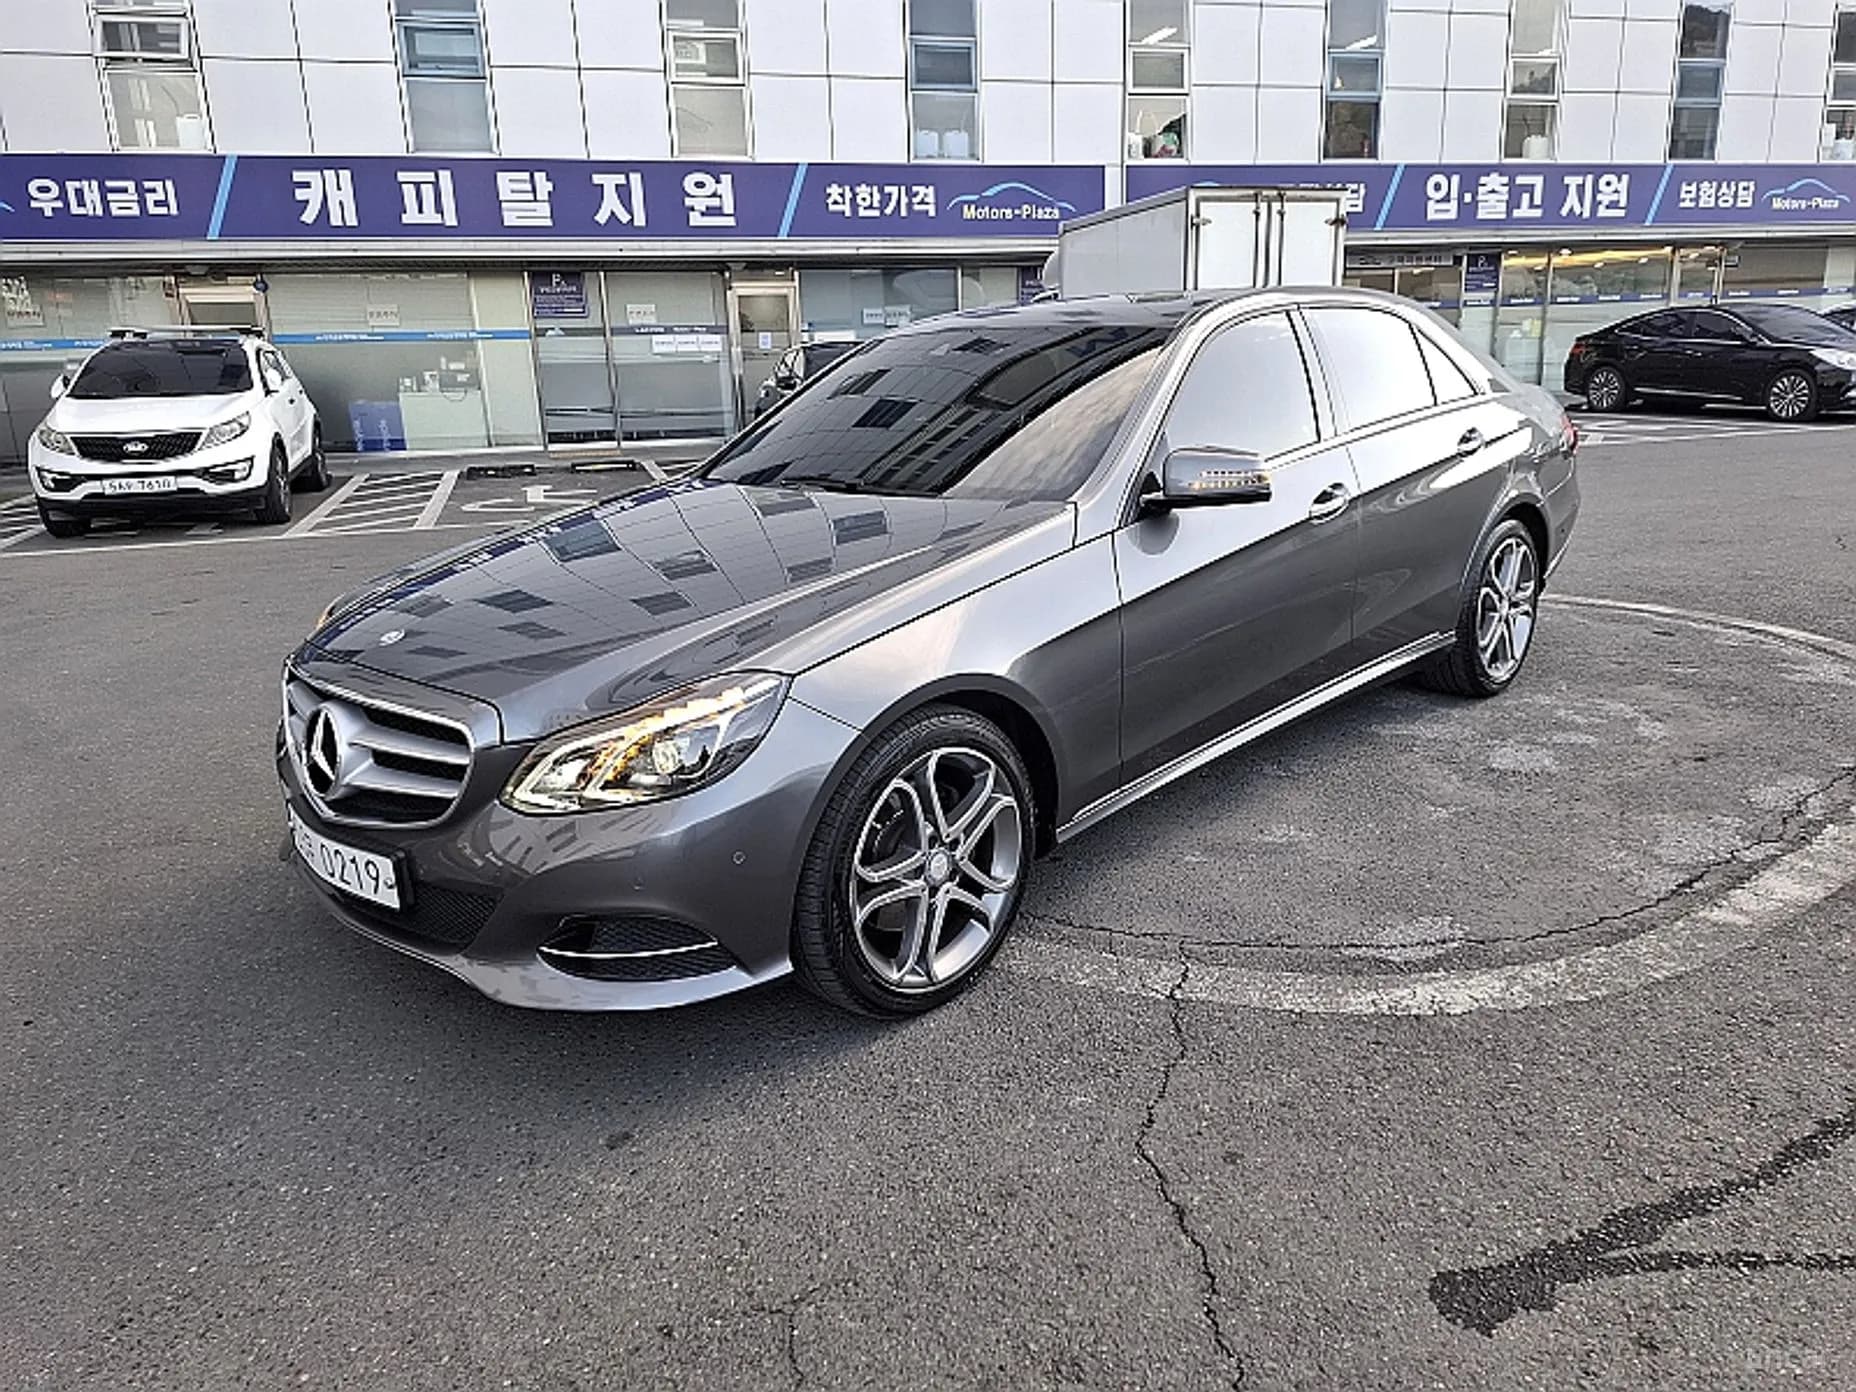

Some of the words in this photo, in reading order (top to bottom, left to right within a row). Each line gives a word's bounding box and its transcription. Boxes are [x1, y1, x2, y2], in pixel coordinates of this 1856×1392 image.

[28, 178, 178, 217] 우대금리
[826, 183, 936, 217] 착한가격
[962, 203, 1061, 220] Motors-Plaza
[1426, 173, 1543, 221] 입·출고
[1560, 173, 1630, 219] 지원
[1678, 180, 1756, 208] 보험상담
[319, 842, 380, 895] 0219
